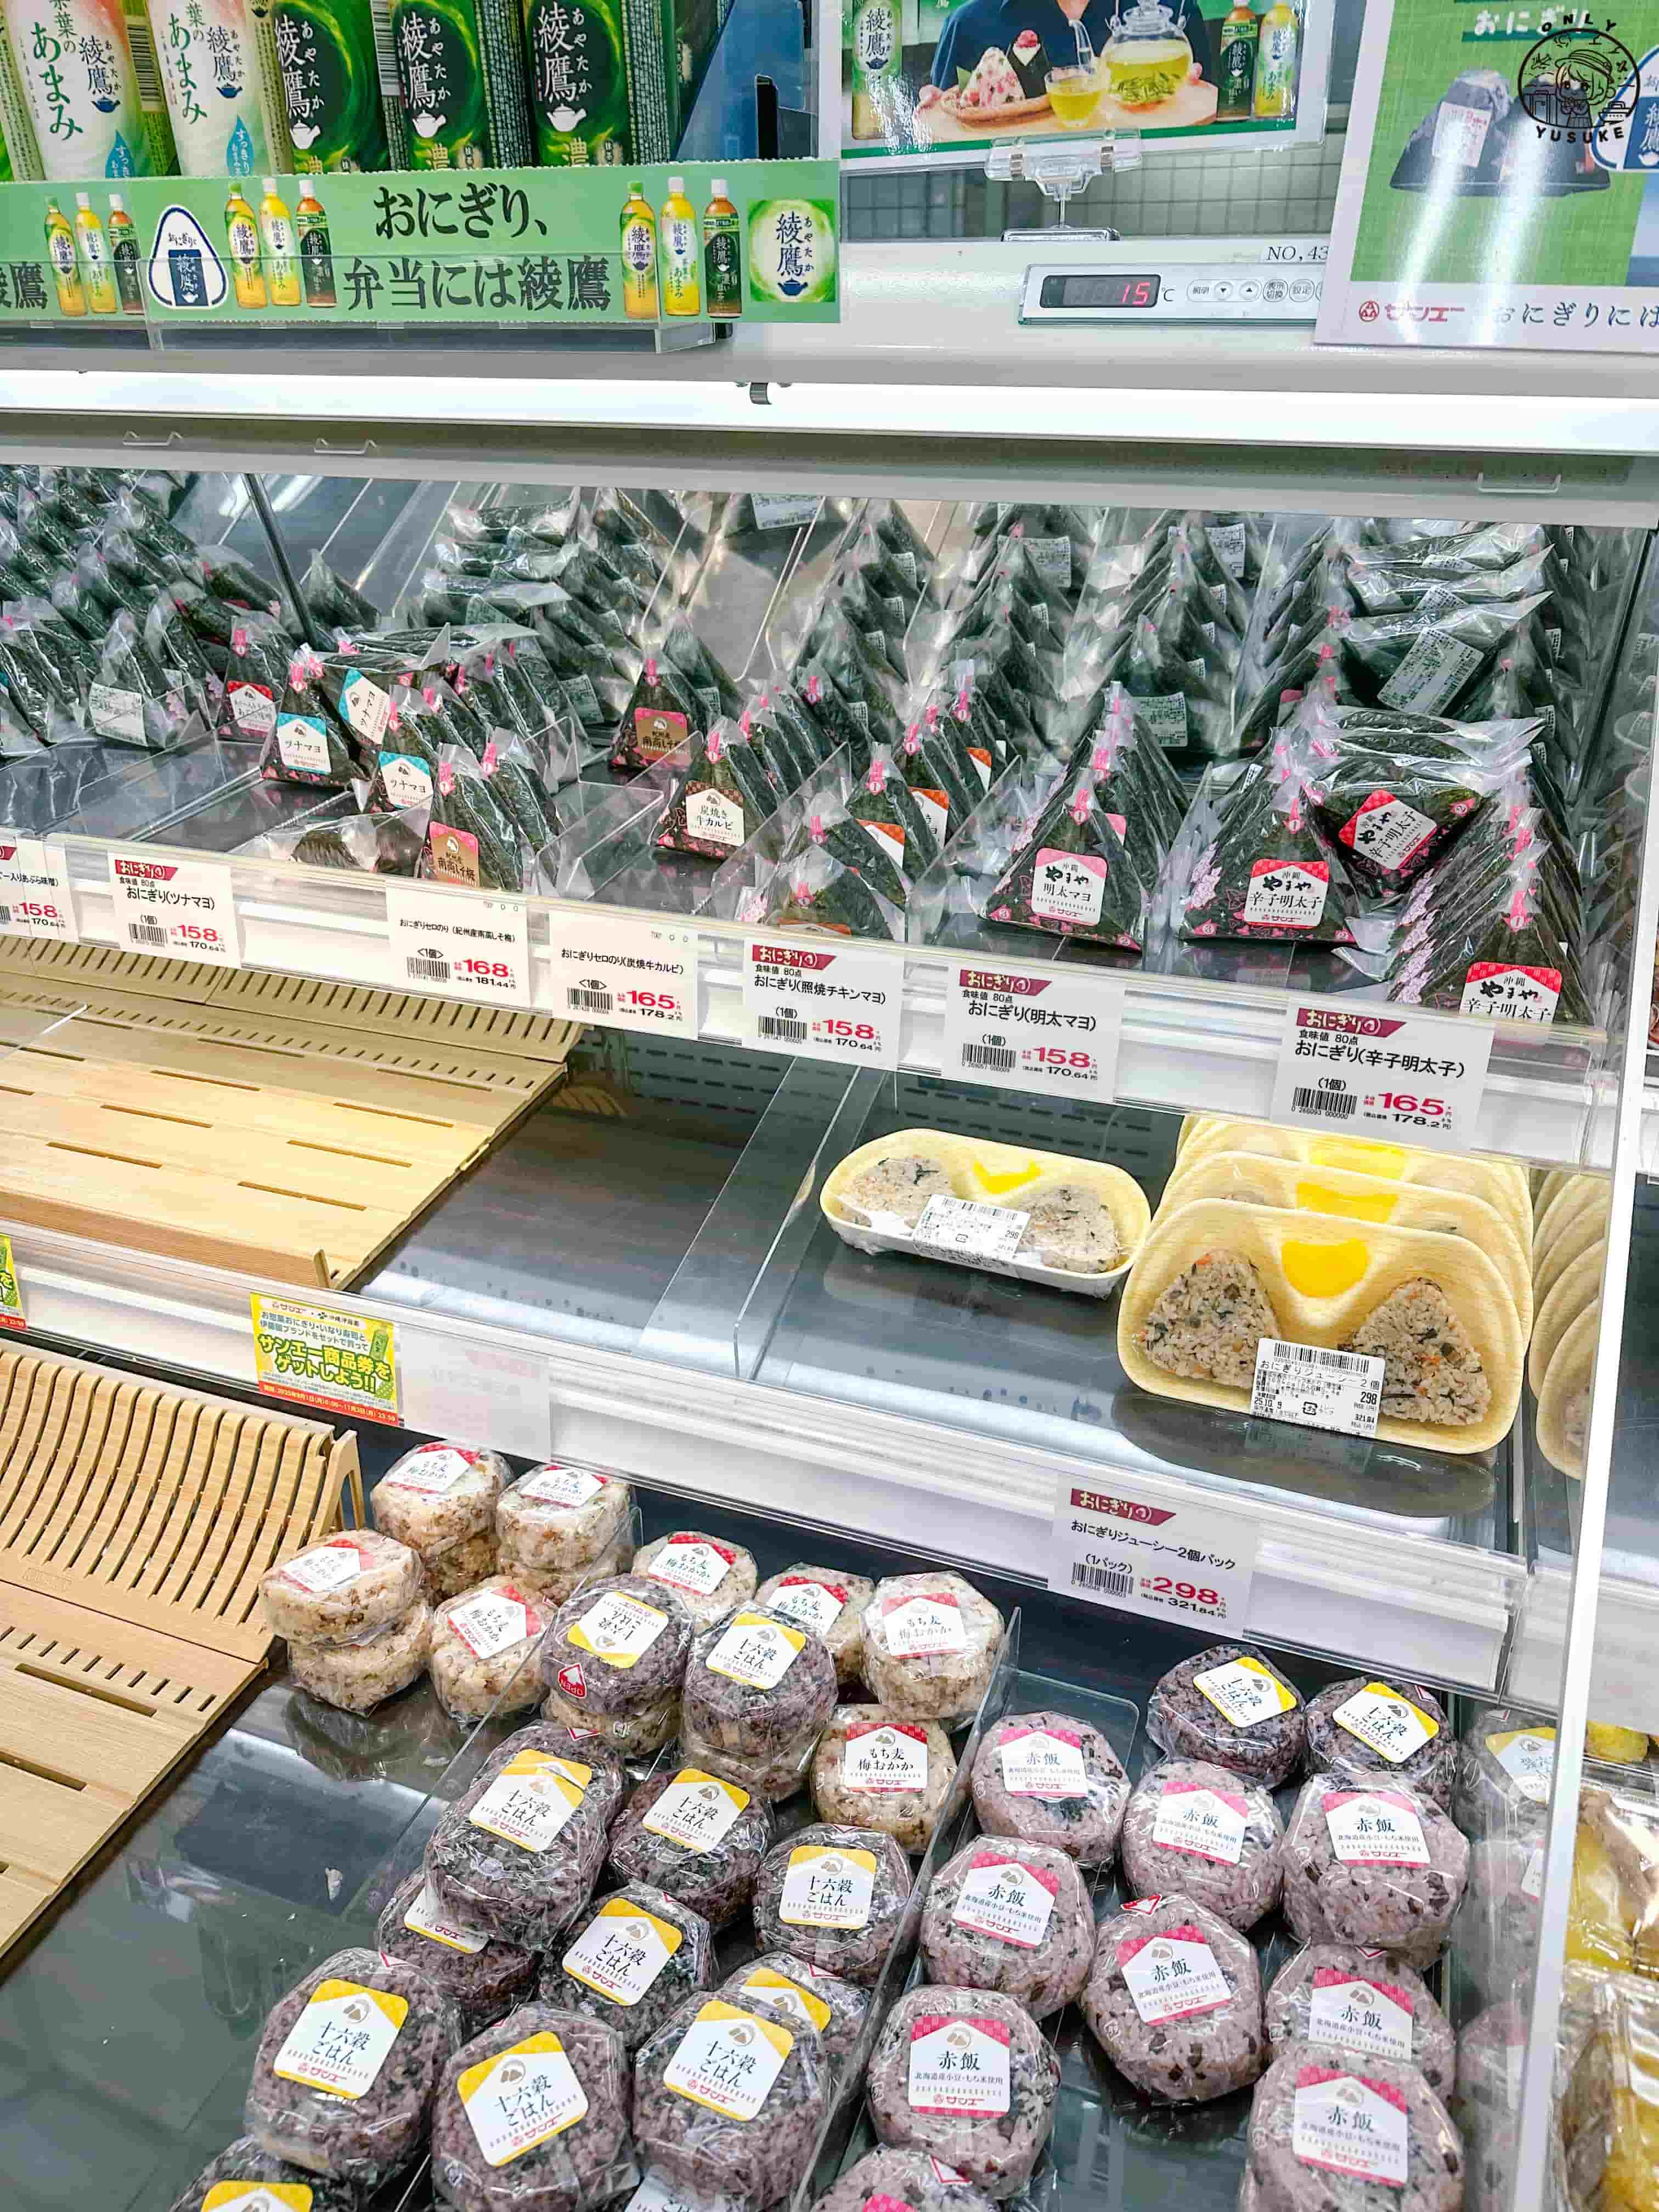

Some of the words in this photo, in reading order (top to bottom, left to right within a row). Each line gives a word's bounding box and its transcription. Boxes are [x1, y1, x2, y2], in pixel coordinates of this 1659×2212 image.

[865, 7, 887, 57] 綾鷹
[207, 26, 234, 83] 綾鷹
[400, 12, 436, 110] 綾鷹
[428, 18, 452, 101] あやたか
[538, 2, 578, 104] 綾鷹
[572, 8, 593, 94] あやたか
[79, 34, 116, 96] 綾鷹
[168, 13, 207, 125] あまみ
[275, 14, 313, 119] 綾鷹
[300, 20, 325, 111] あやたか
[31, 21, 84, 141] あまみ
[373, 183, 548, 240] おにぎり、
[631, 226, 646, 260] 綾鷹
[776, 210, 805, 277] 綾鷹
[804, 217, 815, 273] あやたか
[343, 256, 612, 312] 弁当には綾鷹
[1119, 282, 1151, 306] 15
[390, 779, 426, 794] ツナマヨ
[1369, 810, 1417, 858] 辛子明太子
[1045, 865, 1089, 885] やまや
[1262, 874, 1312, 891] やまや
[127, 887, 215, 911] おにぎり(ツナマヨ)
[1043, 882, 1091, 901] 明太マヨ
[1248, 891, 1323, 915] 辛子明太子
[19, 902, 58, 918] 158
[177, 924, 219, 943] 158
[462, 958, 509, 978] 168
[626, 990, 675, 1010] 165
[754, 975, 887, 1005] おにぎり(照焼チキンマヨ)
[1480, 980, 1539, 1000] やまや
[775, 1006, 798, 1019] (1個)
[968, 1000, 1097, 1032] おにぎり(明太マヨ)
[1468, 997, 1551, 1023] 辛子明太子
[822, 1019, 874, 1040] 158
[981, 1033, 1007, 1047] (1個)
[1298, 1029, 1330, 1042] 食味値
[1335, 1034, 1359, 1046] 80点
[1033, 1046, 1091, 1068] 158
[1295, 1040, 1466, 1079] おにぎり(辛子明太子)
[1046, 1066, 1088, 1080] 170.64
[1318, 1076, 1347, 1092] (1個)
[1378, 1092, 1445, 1116] 165
[1391, 1113, 1441, 1130] 178.2
[258, 1334, 391, 1383] サンエー商品券を
[1360, 1391, 1378, 1406] 298
[1071, 1519, 1236, 1571] おにぎりジューシー2個パック
[1085, 1553, 1133, 1575] (1パック)
[1153, 1576, 1219, 1605] 298
[1167, 1597, 1215, 1617] 321.84
[733, 1650, 765, 1669] ごはん
[739, 1638, 778, 1661] 十六穀
[560, 1679, 585, 1697] OPEN
[1362, 1715, 1393, 1739] ごはん
[1369, 1707, 1408, 1737] 十六穀
[857, 1758, 915, 1771] 梅おかか
[870, 1747, 905, 1760] もち麦
[1025, 1752, 1062, 1766] 赤飯
[501, 1803, 537, 1827] ごはん
[508, 1789, 552, 1819] 十六穀
[679, 1795, 719, 1820] 十六穀
[672, 1808, 703, 1830] ごはん
[1183, 1808, 1218, 1827] 赤飯
[1356, 1818, 1396, 1833] 赤飯
[806, 1875, 854, 1894] 十六穀
[987, 1883, 1026, 1907] 赤飯
[806, 1890, 848, 1906] ごはん
[603, 1933, 647, 1967] 十六穀
[596, 1949, 629, 1977] ごはん
[1150, 1957, 1192, 1983] 赤飯
[1340, 2004, 1383, 2030] 赤飯
[319, 2021, 371, 2051] 十六穀
[312, 2041, 352, 2066] ごはん
[706, 2040, 757, 2075] 十六穀
[936, 2050, 981, 2072] 赤飯
[699, 2057, 742, 2089] ごはん
[495, 2074, 552, 2112] 十六穀
[507, 2092, 553, 2127] ごはん
[1327, 2106, 1375, 2134] 赤飯
